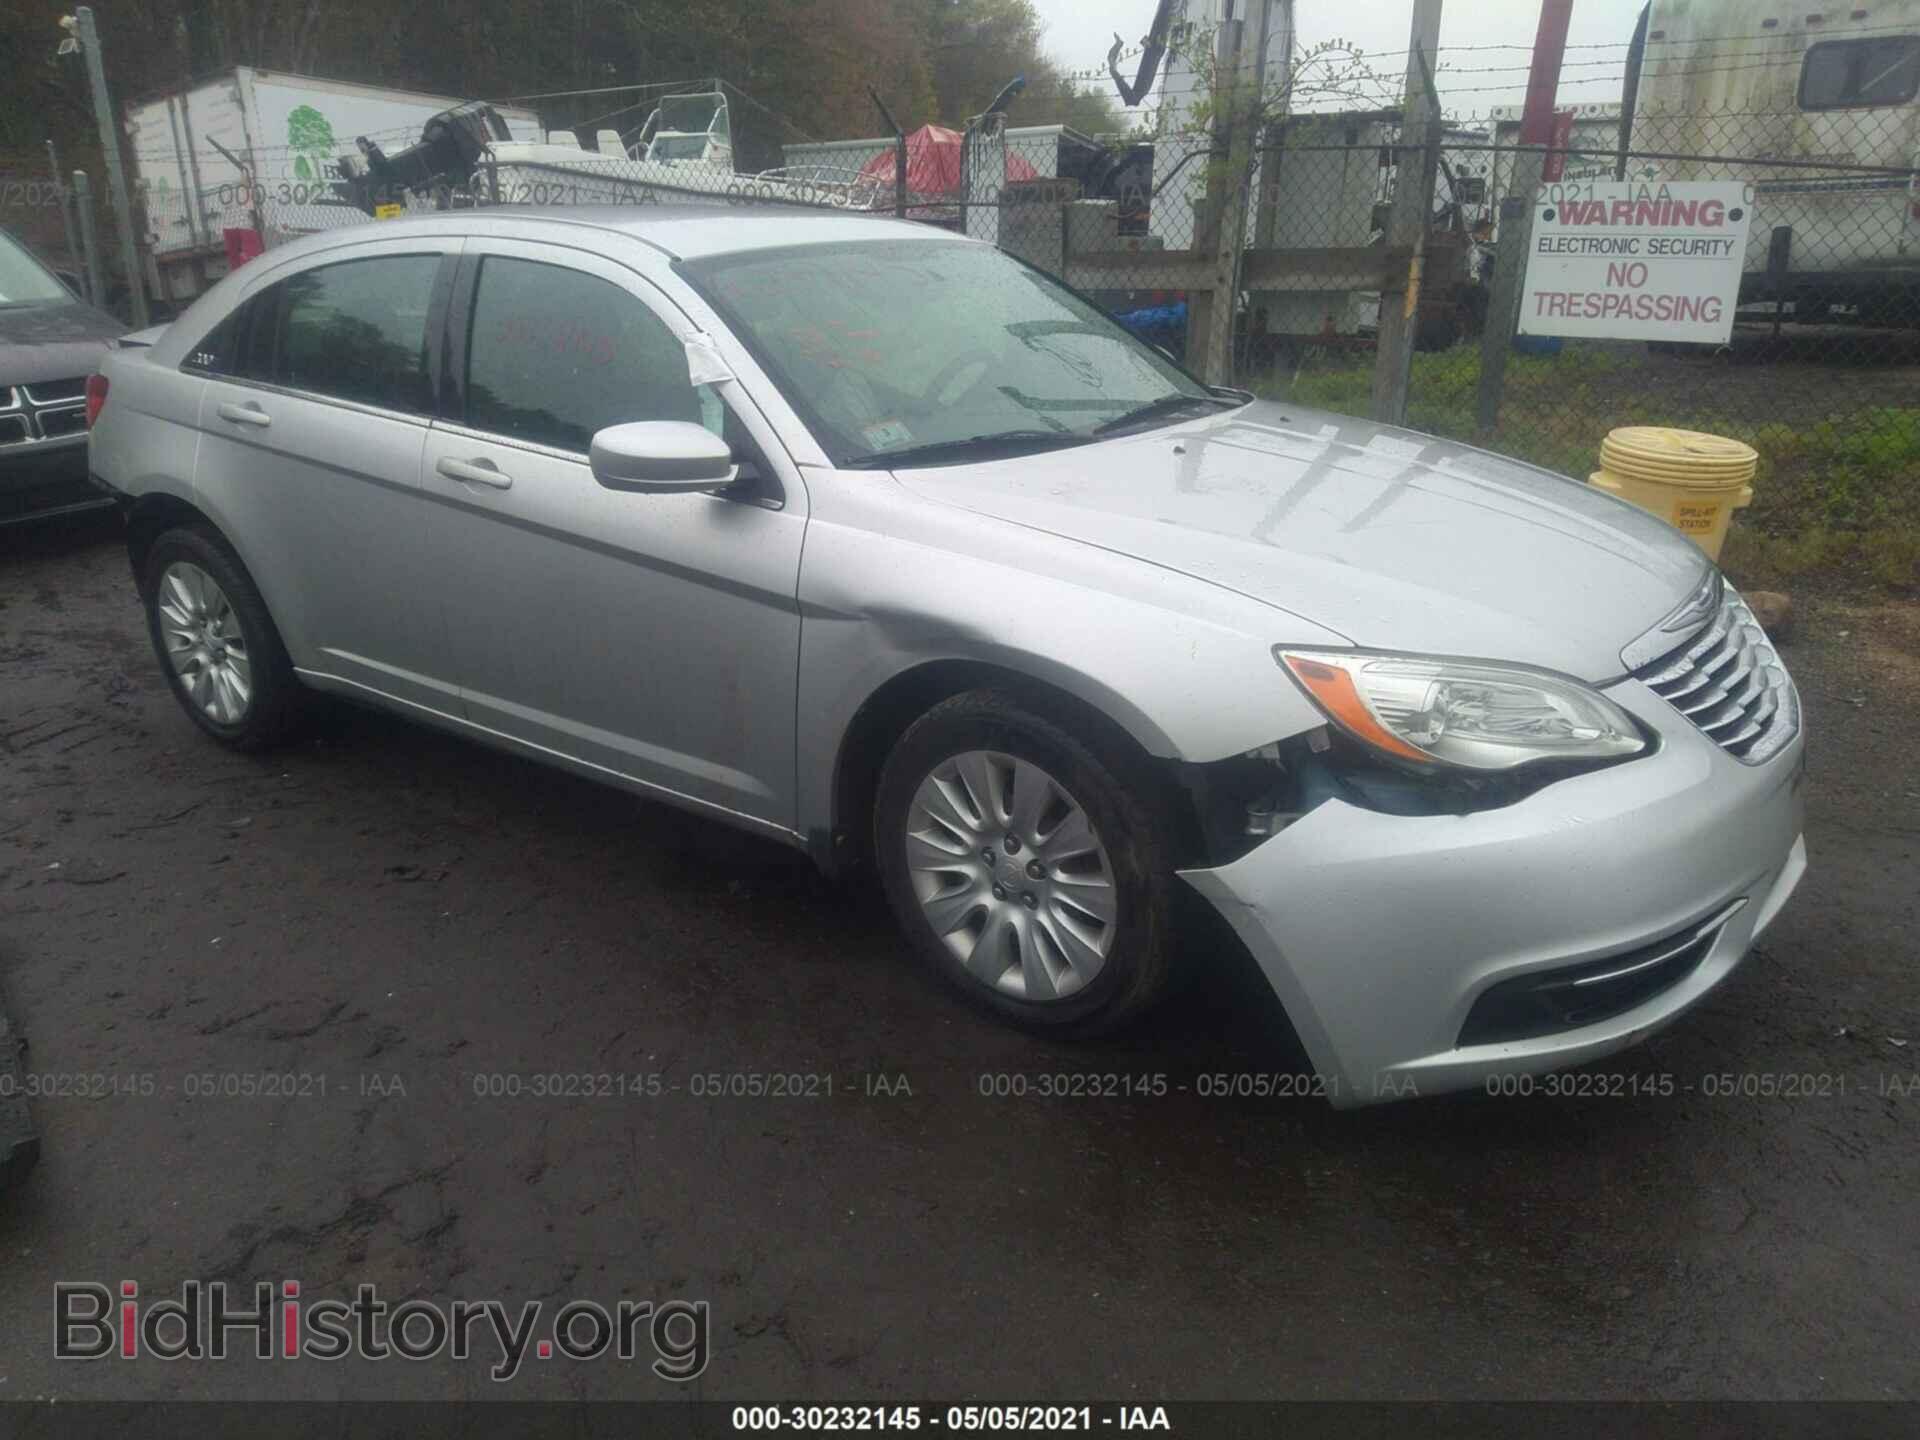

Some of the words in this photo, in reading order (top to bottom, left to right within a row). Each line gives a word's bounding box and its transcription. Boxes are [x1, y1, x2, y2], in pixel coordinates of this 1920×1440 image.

[1557, 200, 1725, 227] WARNING
[1537, 237, 1640, 255] ELECTRONIC
[1647, 238, 1735, 256] SECURITY
[1606, 262, 1649, 288] NO
[1534, 292, 1723, 323] TRESPASSING
